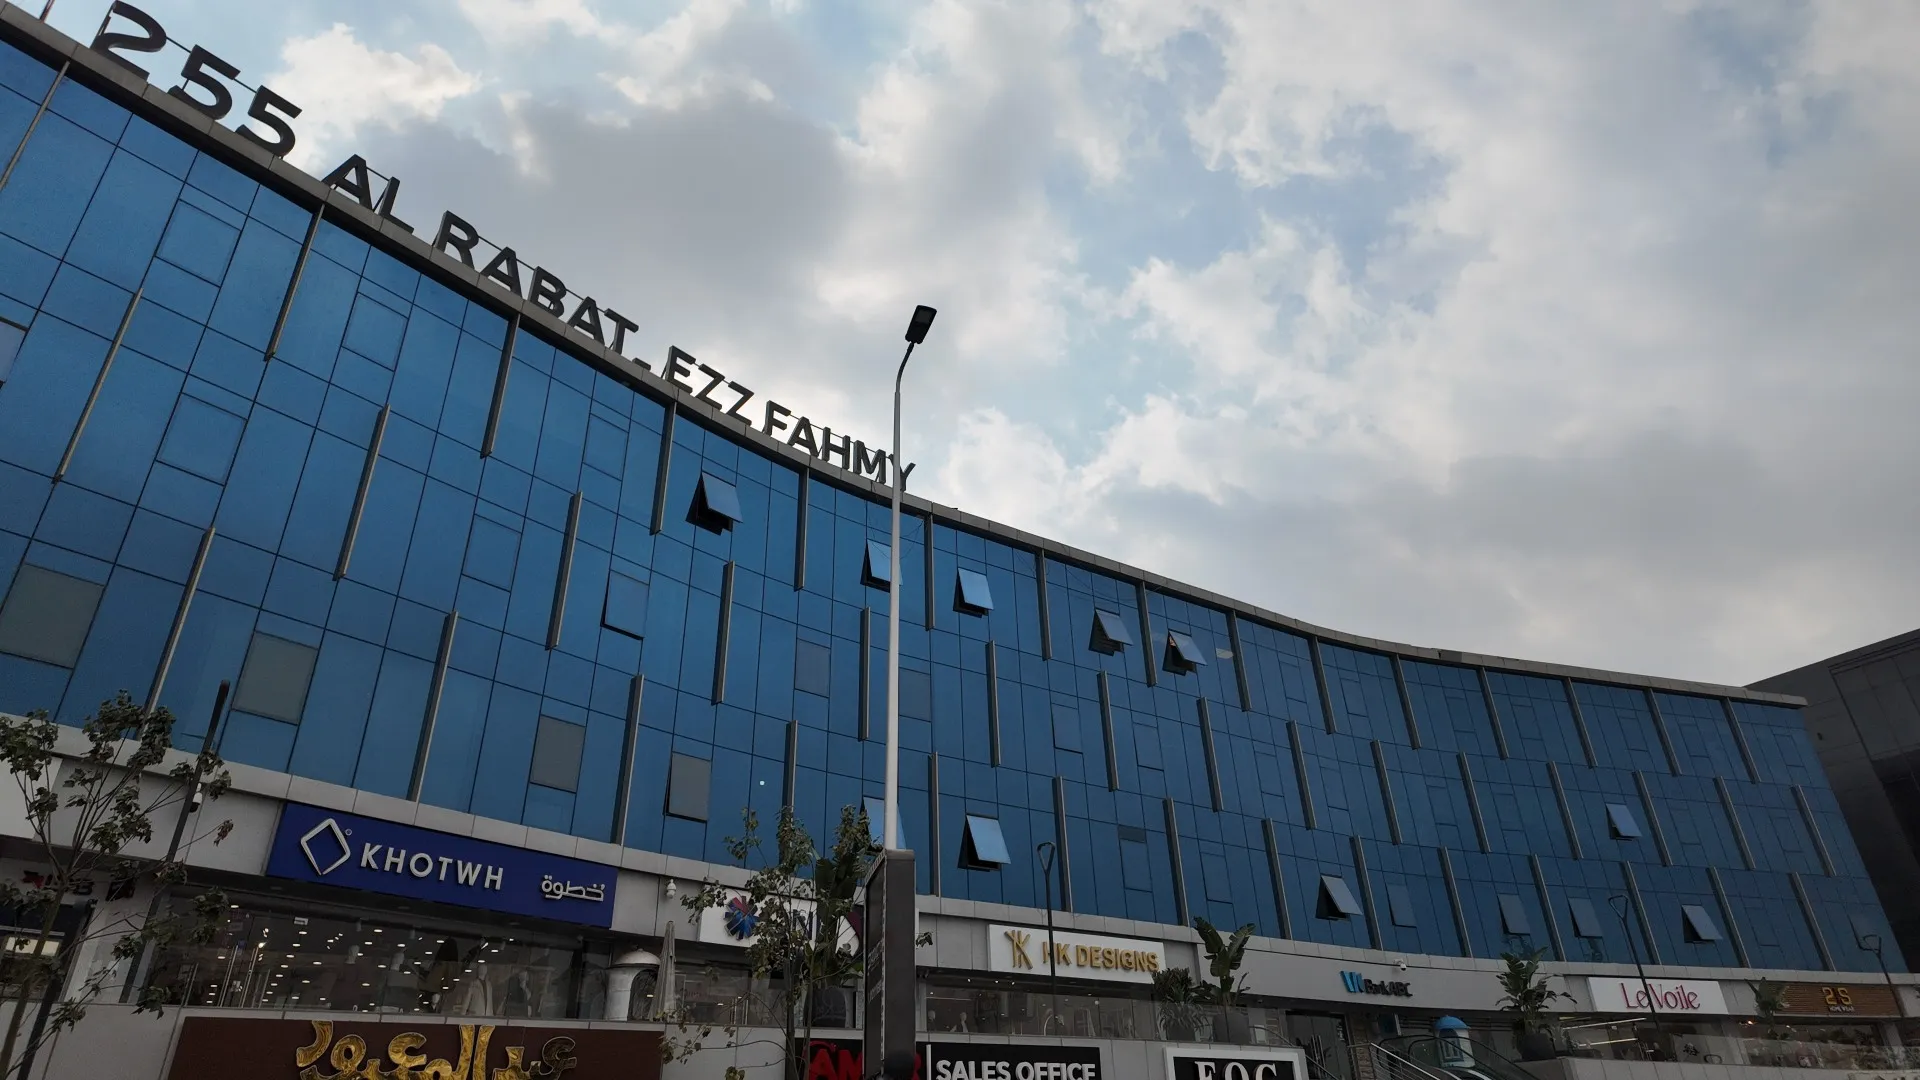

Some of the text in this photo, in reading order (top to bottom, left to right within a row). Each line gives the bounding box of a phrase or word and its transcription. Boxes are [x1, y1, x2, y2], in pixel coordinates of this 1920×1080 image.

[91, 0, 302, 156] 255
[322, 154, 415, 233] AL
[665, 345, 755, 427] EZZ
[763, 400, 916, 492] FAHMY
[360, 842, 504, 891] KHOTWH
[1075, 944, 1160, 973] DESIGNS
